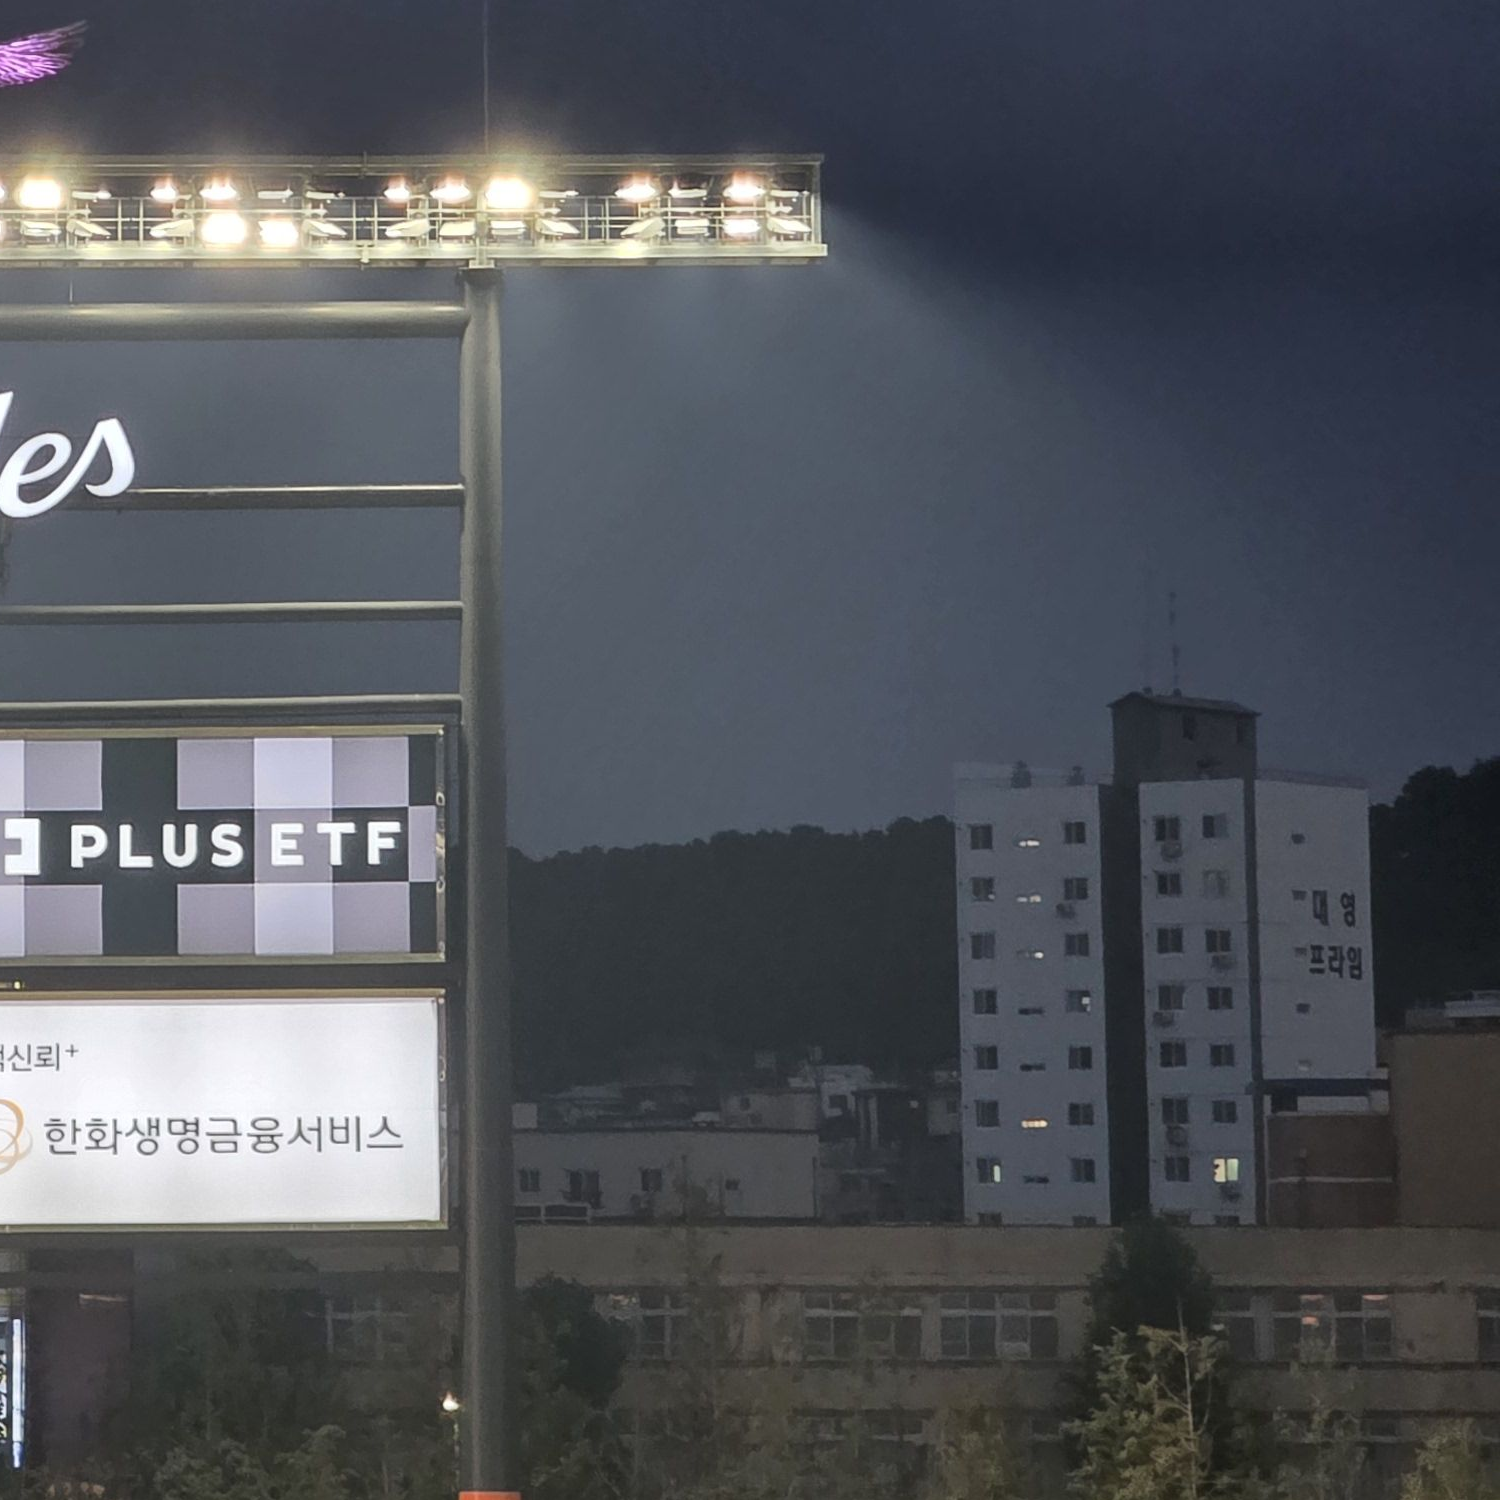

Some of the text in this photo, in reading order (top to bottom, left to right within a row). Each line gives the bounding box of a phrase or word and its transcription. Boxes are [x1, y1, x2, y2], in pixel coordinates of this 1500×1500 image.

[70, 821, 401, 869] PLUS ETF
[1309, 945, 1363, 980] 프라임
[43, 1115, 404, 1156] 한화생명금융서비스
